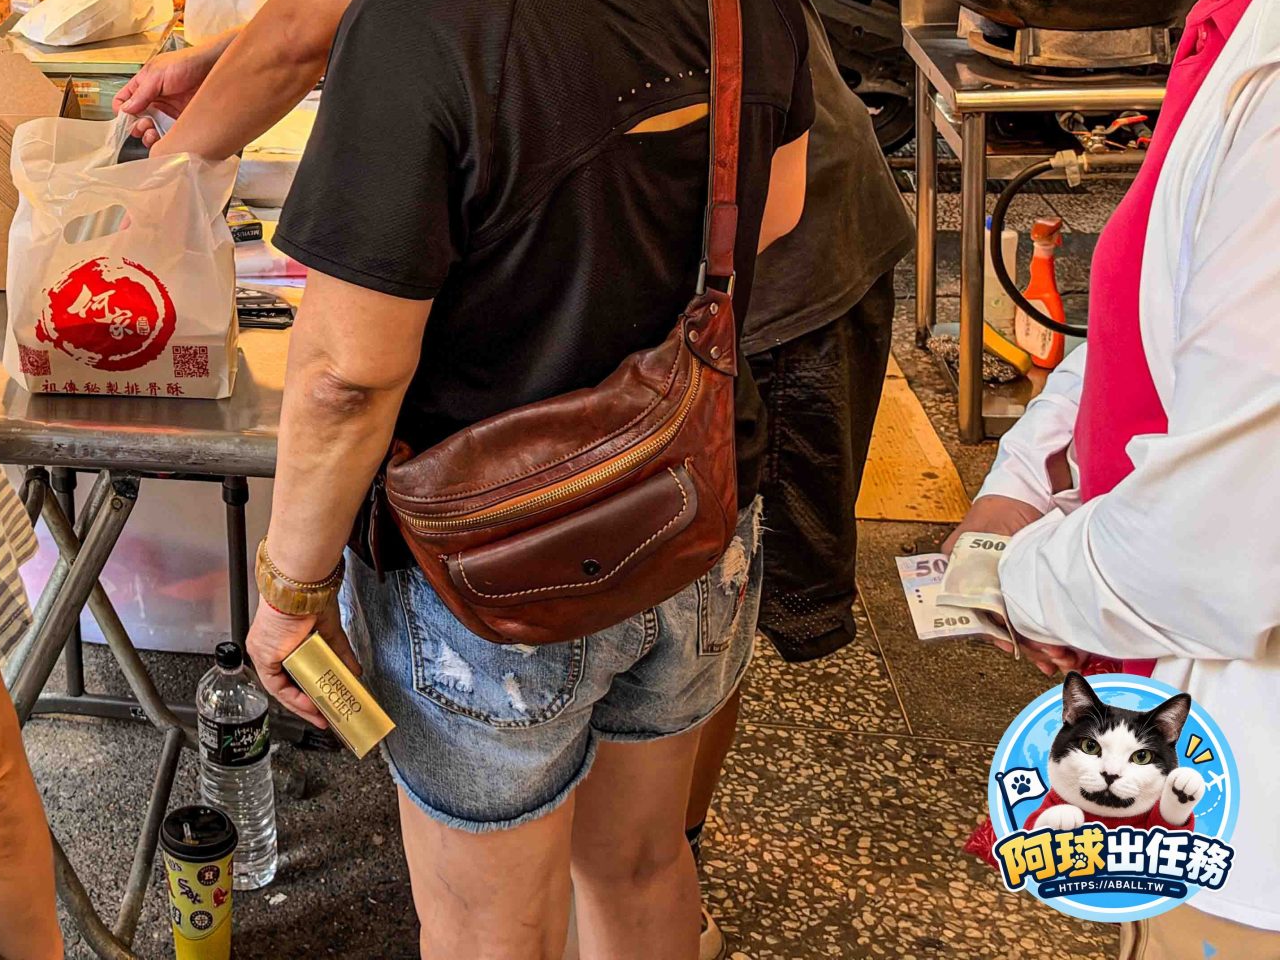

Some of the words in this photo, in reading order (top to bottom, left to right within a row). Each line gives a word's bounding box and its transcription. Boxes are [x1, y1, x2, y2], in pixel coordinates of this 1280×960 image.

[66, 283, 134, 340] 何家
[968, 538, 1007, 552] 500
[915, 557, 948, 579] 50
[932, 615, 971, 629] 500
[315, 675, 353, 723] ROCHER
[322, 667, 363, 716] FERRERO
